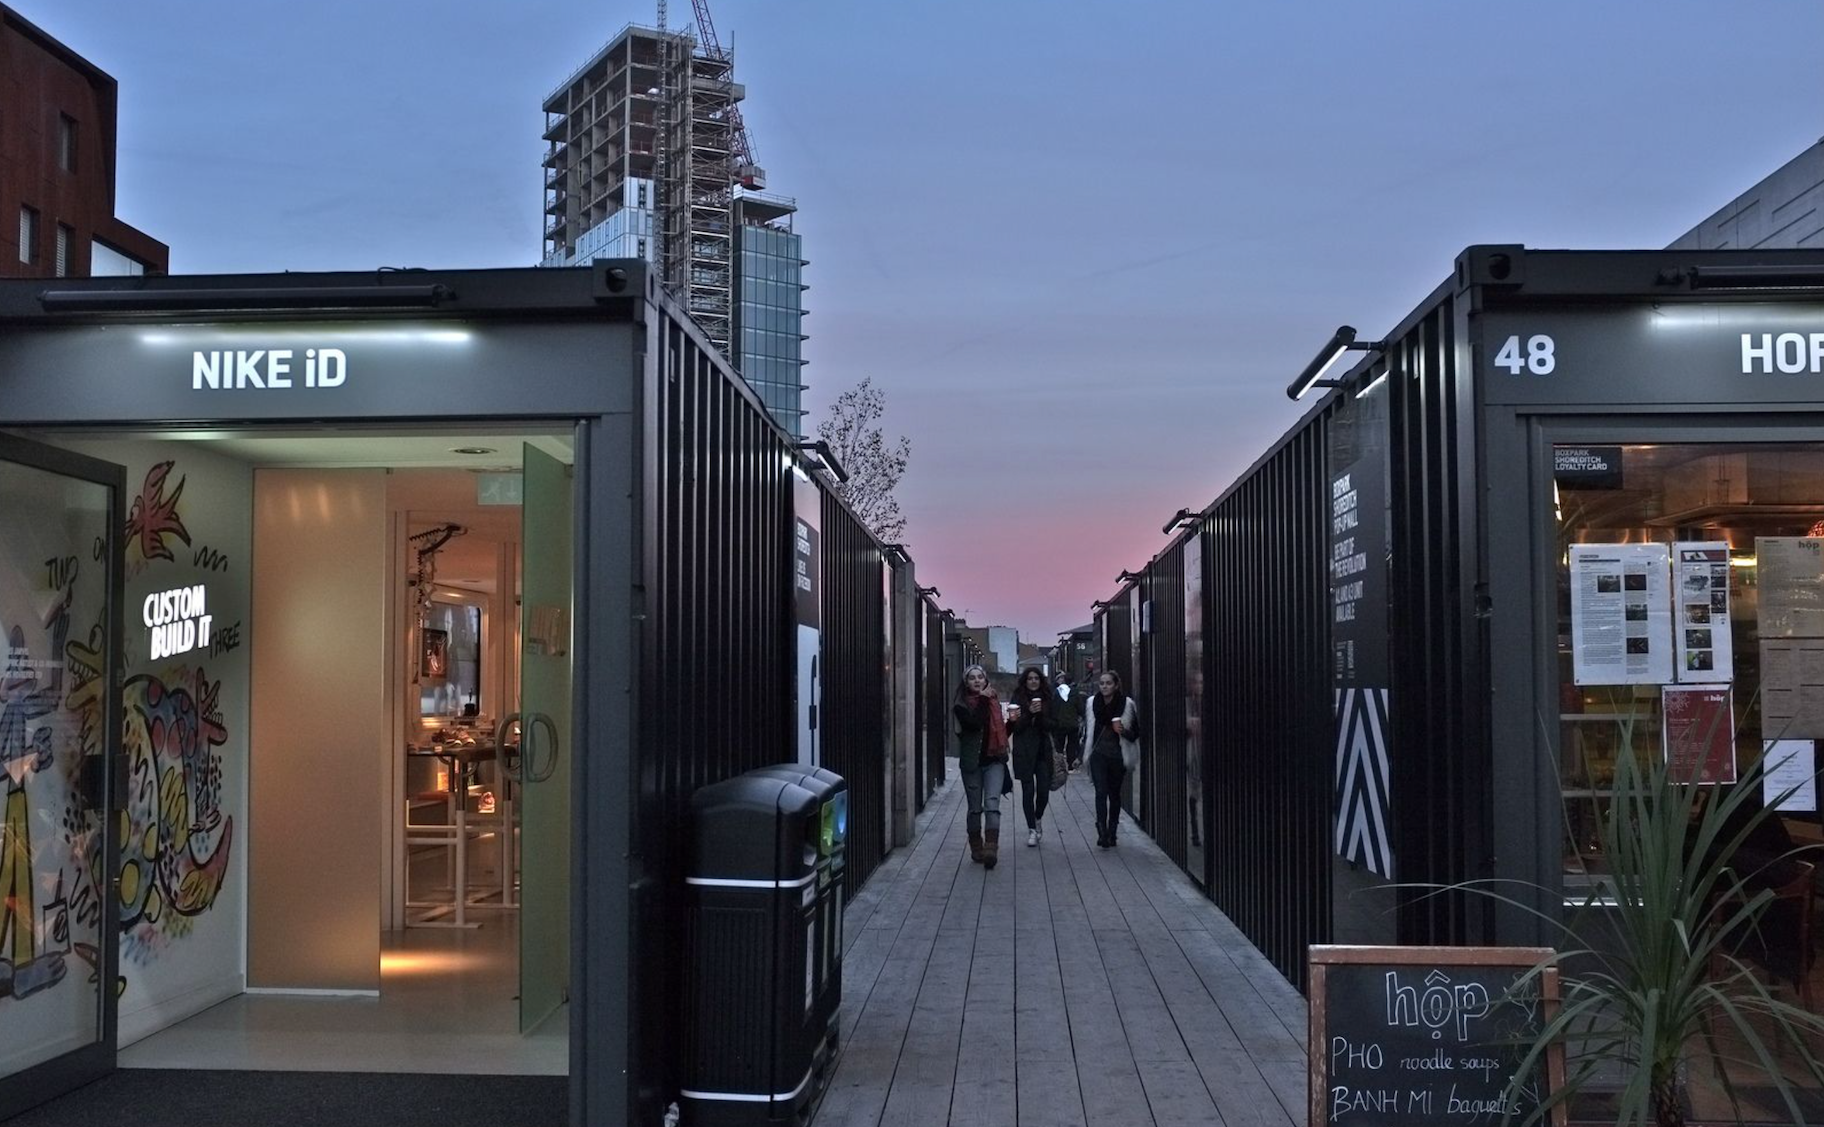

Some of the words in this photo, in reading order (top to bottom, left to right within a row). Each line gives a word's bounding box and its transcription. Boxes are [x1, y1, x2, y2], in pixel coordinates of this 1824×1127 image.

[193, 350, 293, 389] NIKE
[305, 348, 347, 388] iD
[1494, 334, 1556, 375] 48
[1555, 456, 1602, 464] SHOREDITCH
[1555, 463, 1587, 471] LOYALTY
[1587, 463, 1608, 471] CARD
[143, 584, 205, 628] CUSTOM
[151, 619, 195, 661] BUILD
[198, 614, 212, 648] IT
[1331, 1036, 1383, 1076] PHO
[1400, 1048, 1454, 1070] noodle
[1460, 1057, 1500, 1083] soups
[1330, 1086, 1398, 1122] BANH
[1408, 1090, 1432, 1115] MI
[1447, 1083, 1523, 1125] baguetts
